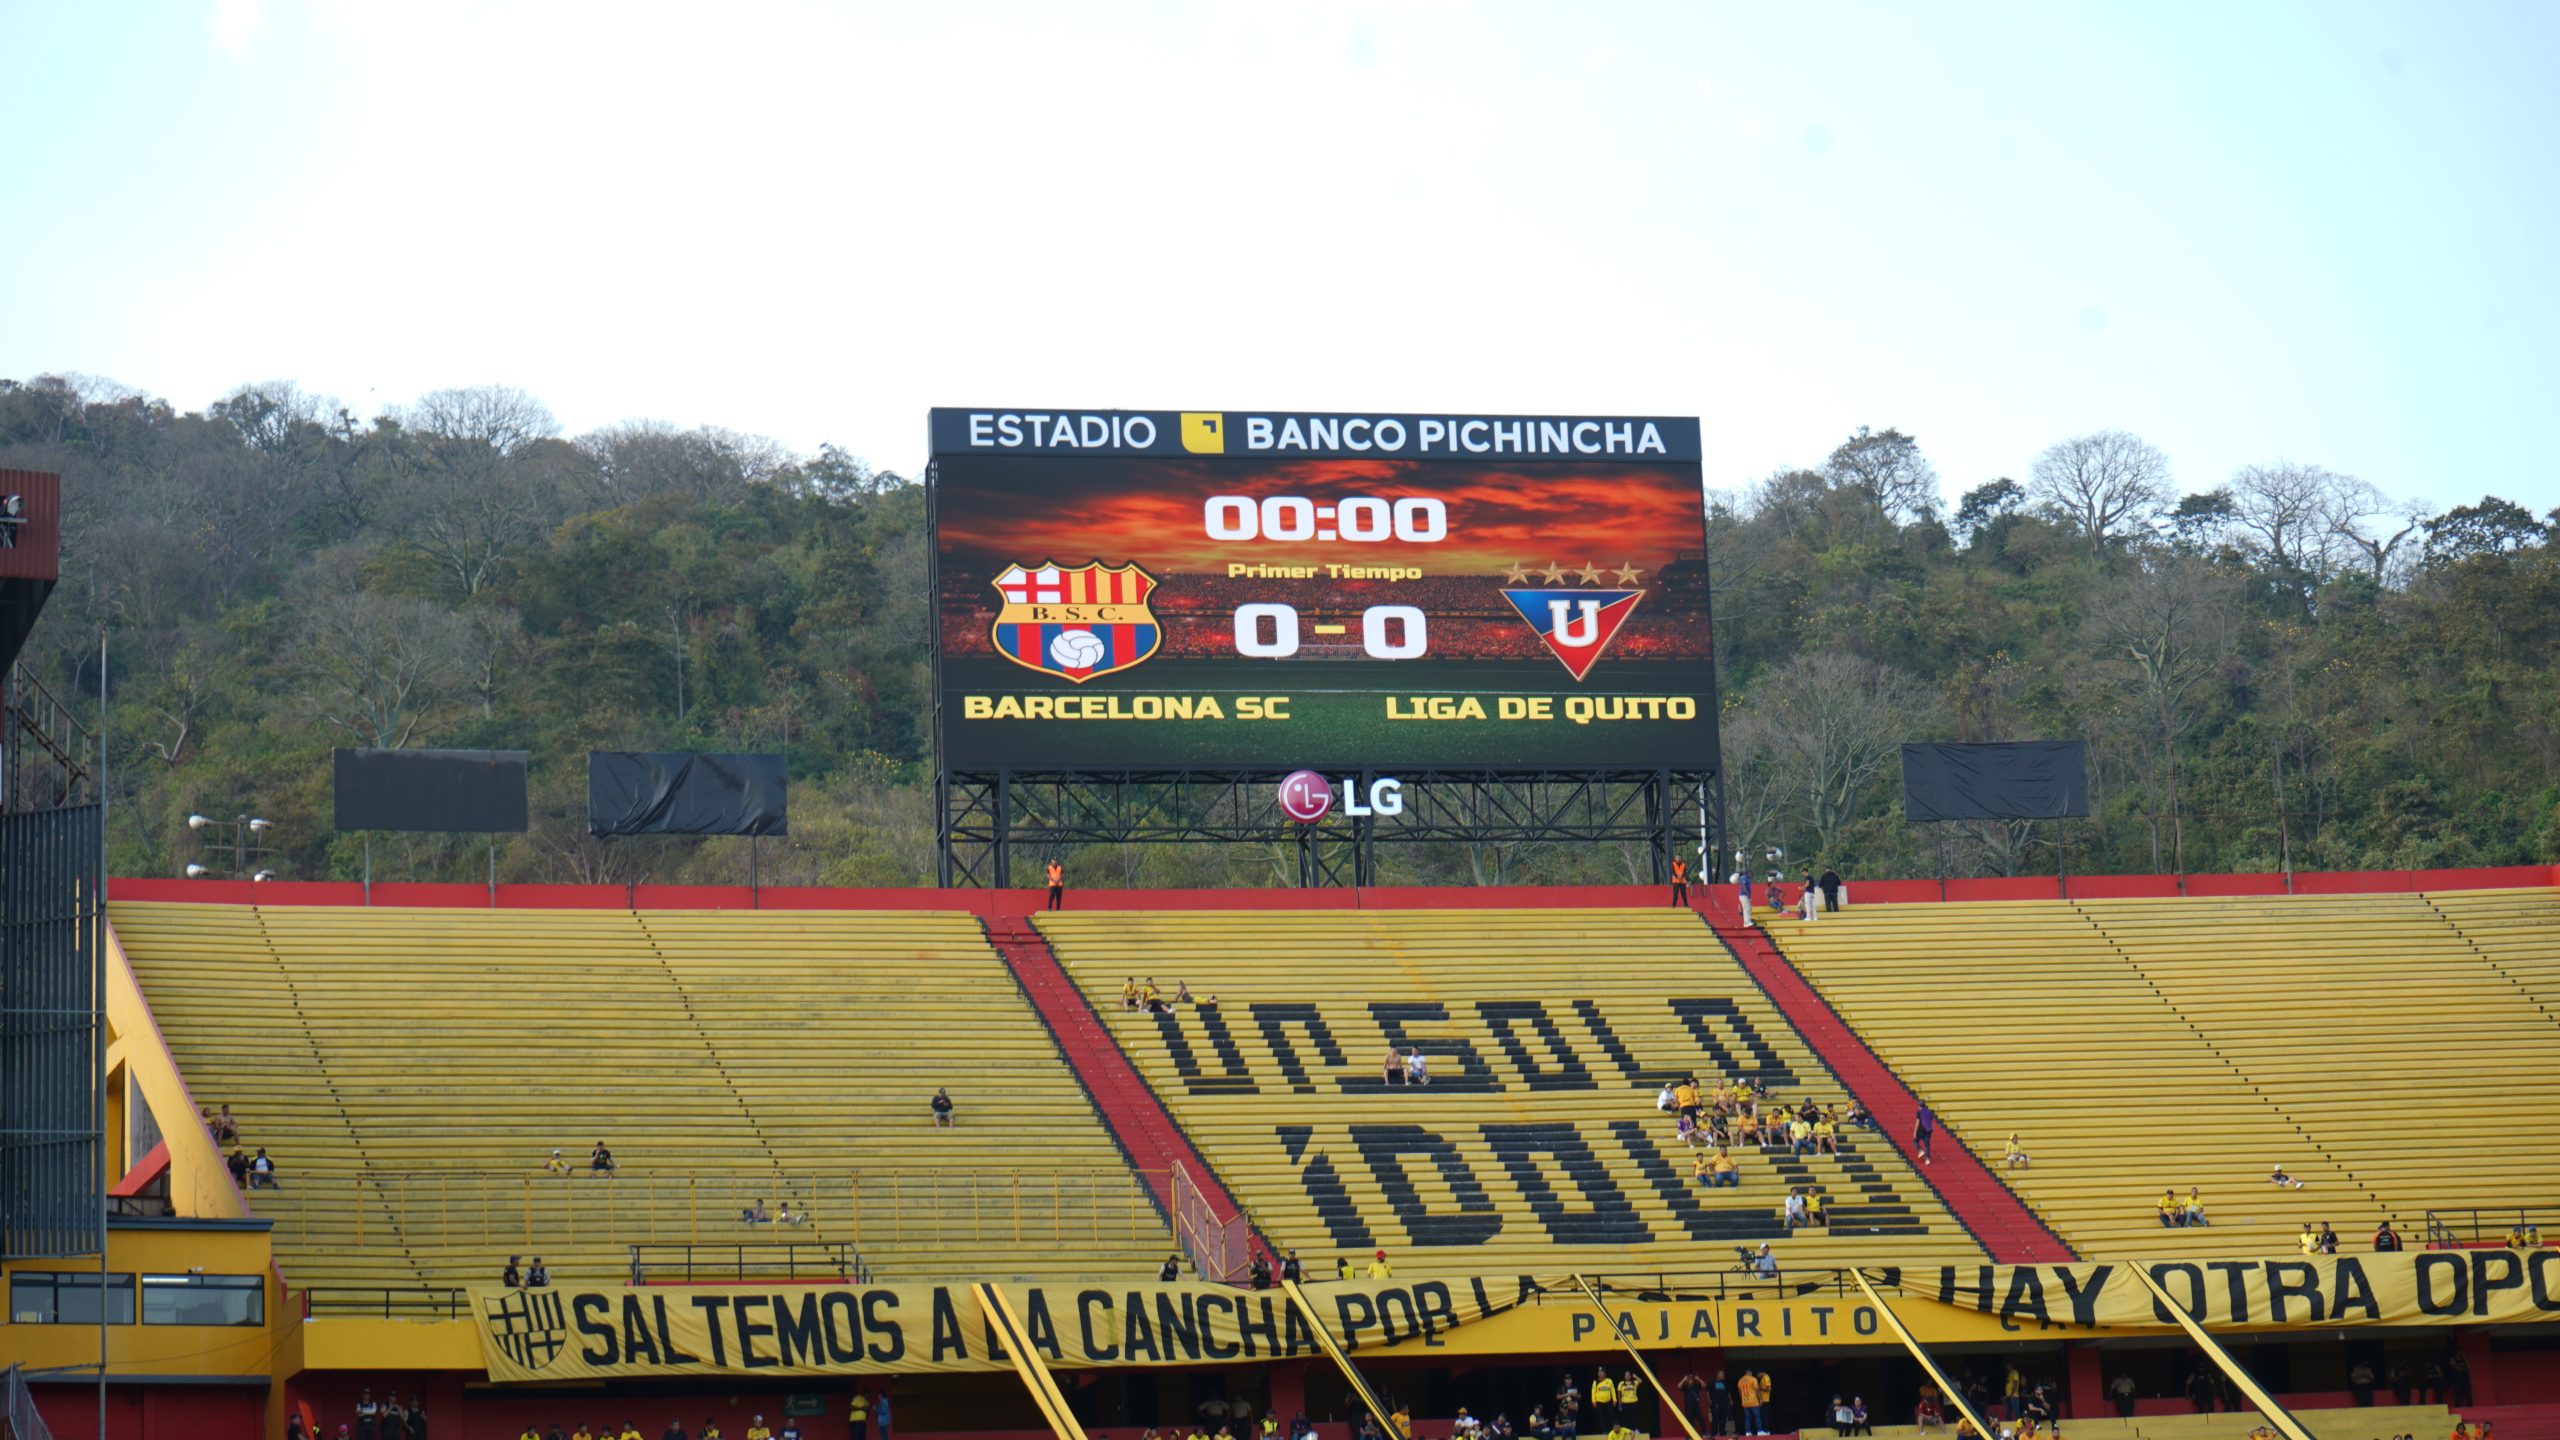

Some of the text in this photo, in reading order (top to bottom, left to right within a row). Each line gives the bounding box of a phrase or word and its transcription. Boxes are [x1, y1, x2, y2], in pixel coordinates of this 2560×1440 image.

[969, 414, 1667, 455] ESTADIO BANCO PICHINCHA
[1204, 495, 1447, 543] 00:00
[1228, 563, 1423, 582] Primer Tiempo
[1032, 606, 1124, 621] B. S. C.
[1233, 603, 1300, 660] 0
[1362, 605, 1428, 661] 0
[1547, 599, 1601, 647] U
[964, 696, 1291, 720] BARCELONA SC
[1386, 696, 1697, 725] LIGA DE QUITO
[1343, 777, 1404, 817] LG
[1335, 999, 1801, 1094] SOLO
[1937, 1264, 2115, 1330] HAY
[2150, 1261, 2382, 1324] OTRA
[572, 1290, 906, 1368] SALTEMOS
[931, 1286, 969, 1362] A
[1077, 1289, 1322, 1361] CANCHA
[1334, 1280, 1461, 1355] POR
[1571, 1304, 1879, 1343] PAJARITO
